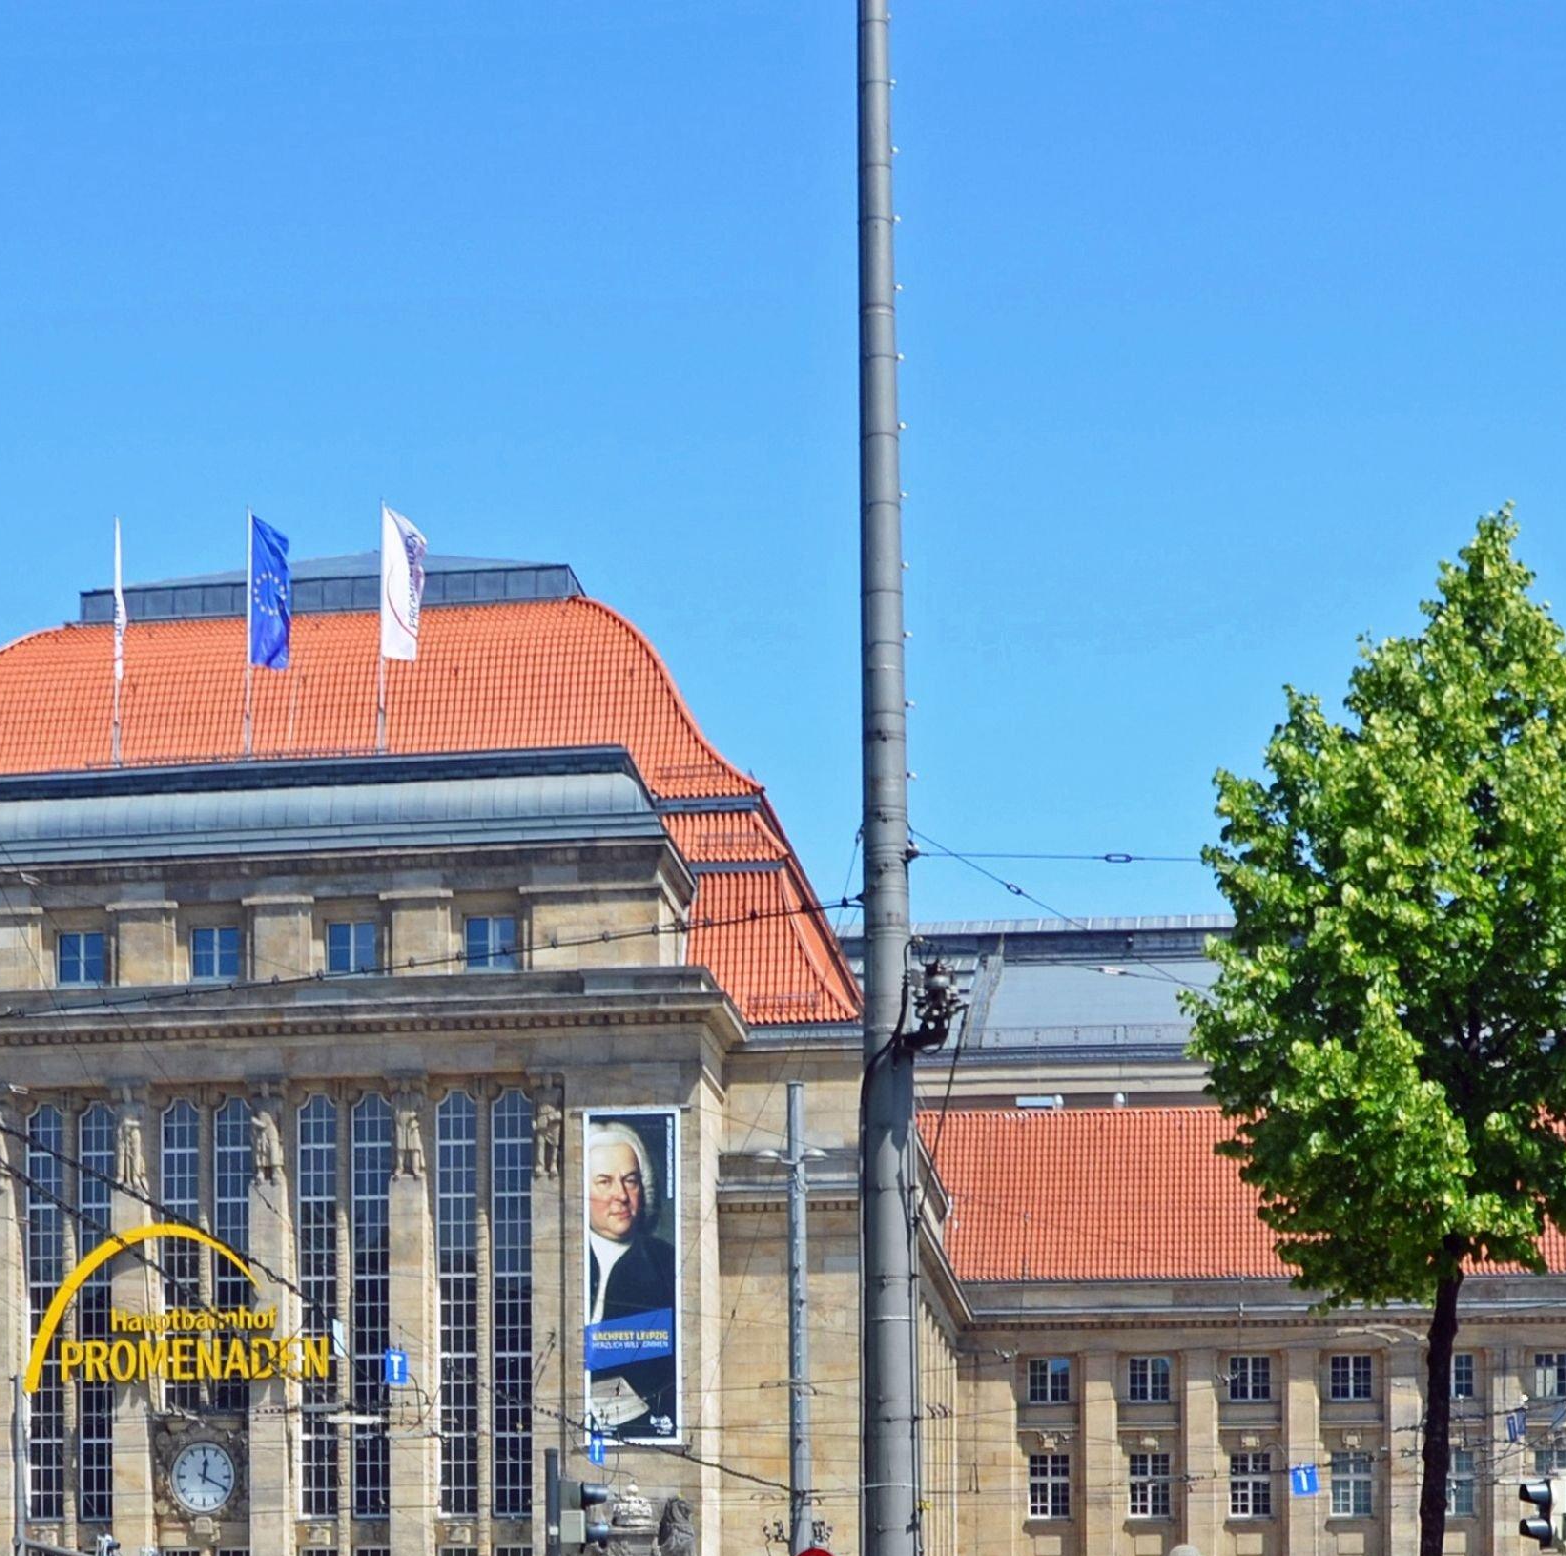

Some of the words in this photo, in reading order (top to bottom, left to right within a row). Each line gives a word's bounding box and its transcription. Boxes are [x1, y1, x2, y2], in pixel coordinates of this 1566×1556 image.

[110, 1306, 277, 1333] Hauptbahnhof
[61, 1336, 329, 1382] PROMENADEN
[390, 1354, 403, 1380] T
